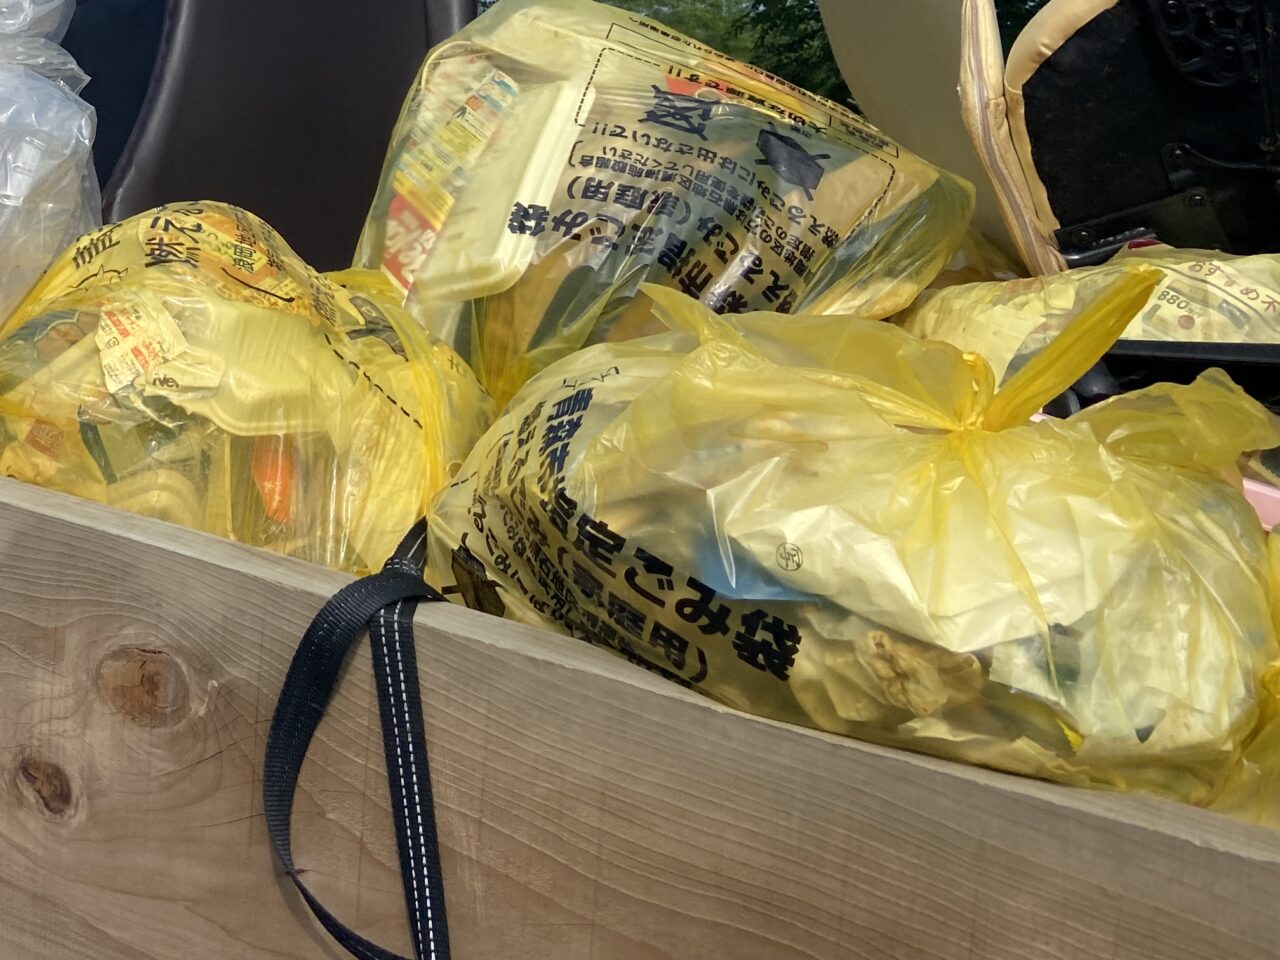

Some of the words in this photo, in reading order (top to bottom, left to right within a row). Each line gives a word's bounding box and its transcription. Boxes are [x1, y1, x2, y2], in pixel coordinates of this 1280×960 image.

[507, 201, 756, 314] 森市指定ごみ袋
